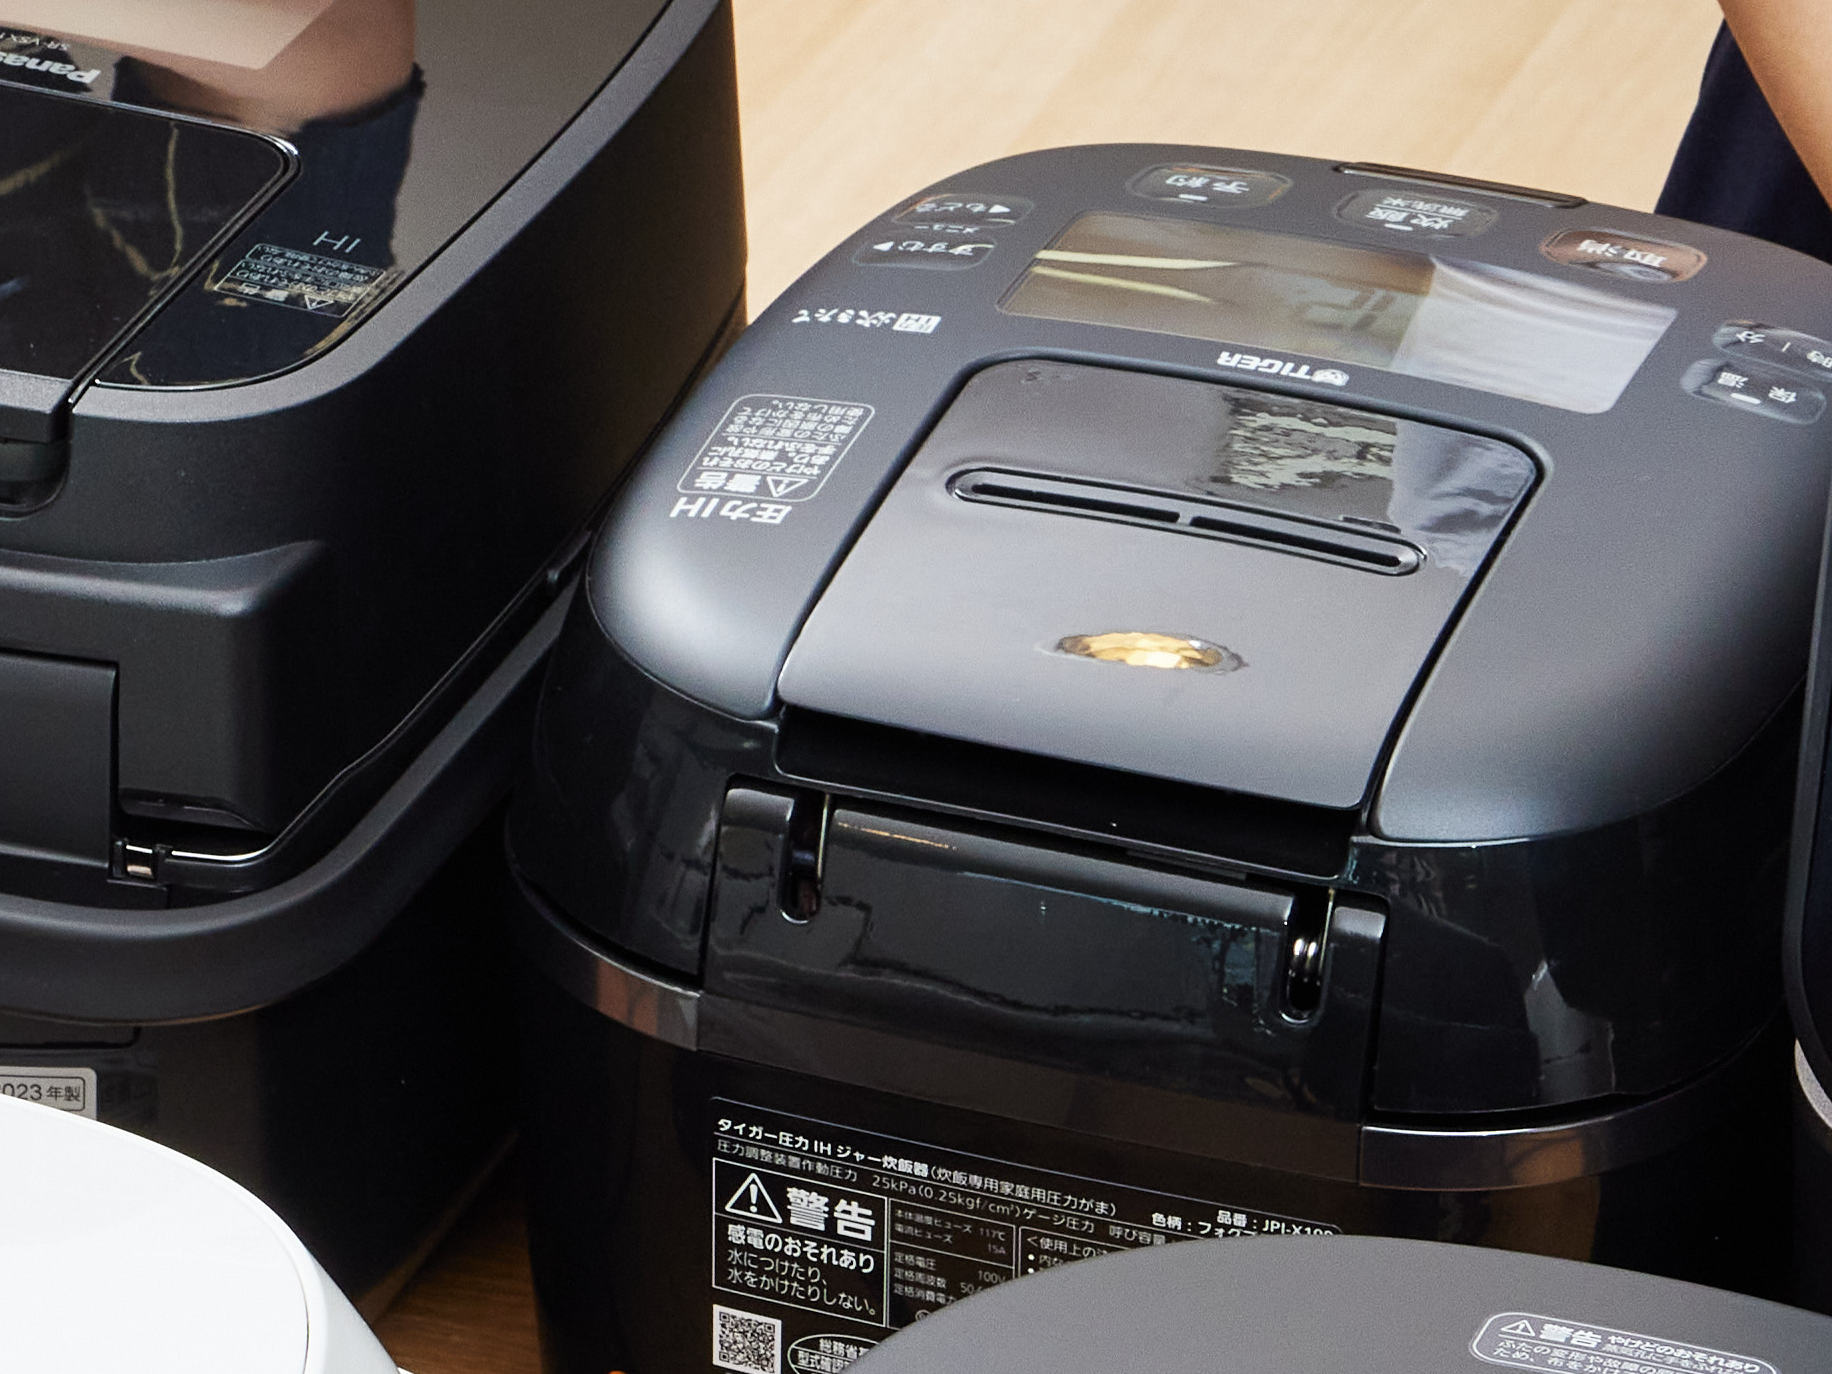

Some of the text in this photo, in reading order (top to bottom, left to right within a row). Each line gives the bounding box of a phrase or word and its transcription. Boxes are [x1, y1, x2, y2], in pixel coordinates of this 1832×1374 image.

[1166, 170, 1249, 197] 予約
[1366, 207, 1453, 230] 炊飯
[313, 231, 361, 253] IH
[1578, 236, 1664, 267] 取消
[1217, 350, 1321, 381] TIGER
[1717, 370, 1796, 404] 保温
[703, 456, 821, 475] やけどのおそれ
[694, 471, 761, 493] 警告
[717, 1119, 832, 1156] タイガー圧力 IH
[786, 1187, 876, 1242] 警告
[727, 1224, 875, 1274] 感電のおそれあり
[727, 1267, 877, 1316] 水をかけたりしない。
[1539, 1323, 1761, 1373] 警告 やけどのおそれあり
